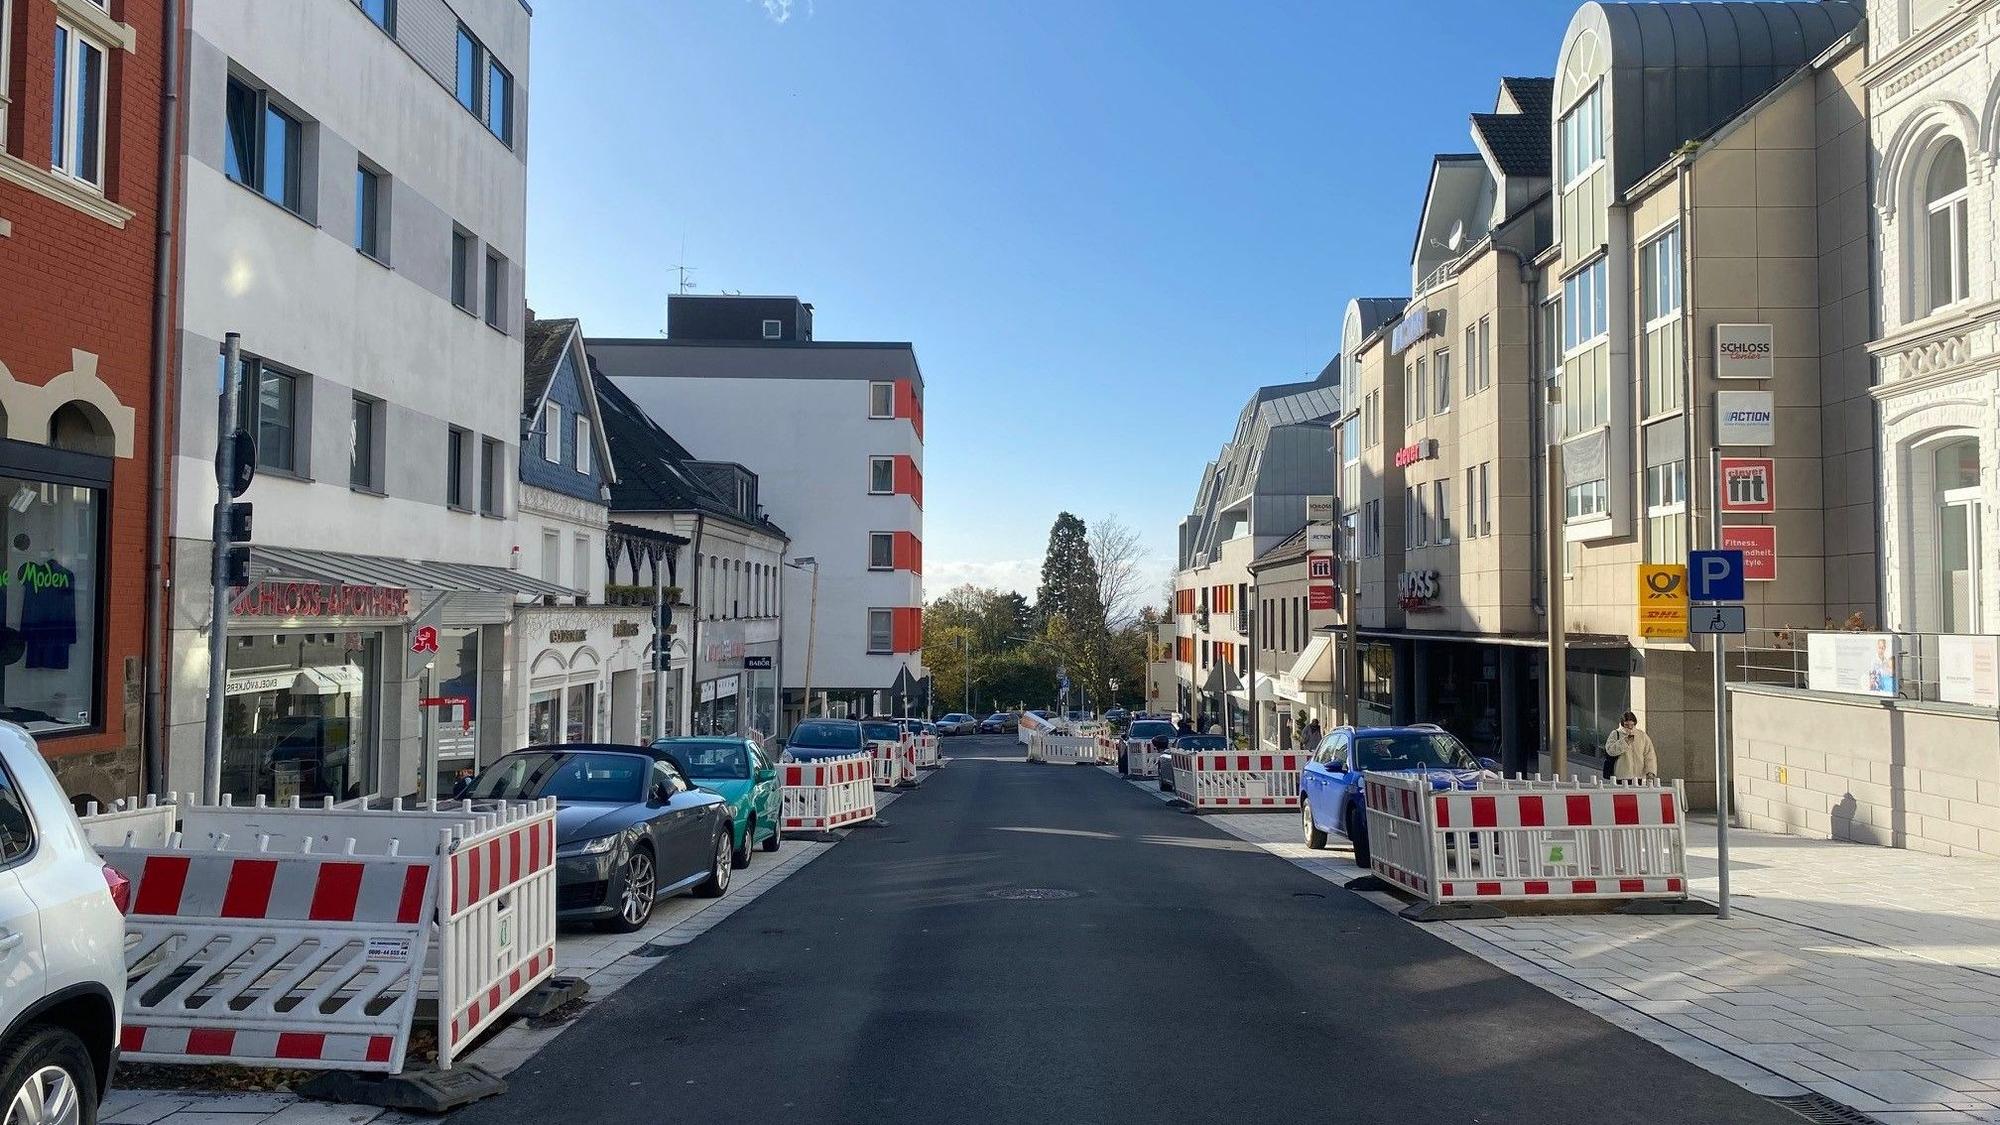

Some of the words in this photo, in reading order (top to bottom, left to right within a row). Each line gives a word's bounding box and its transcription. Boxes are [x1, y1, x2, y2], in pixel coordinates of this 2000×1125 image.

[1720, 342, 1770, 353] SCHLOSS
[1729, 411, 1770, 422] ACTION
[1727, 468, 1763, 478] clever
[1728, 475, 1765, 502] fit
[1724, 539, 1759, 547] Fitness.
[1745, 549, 1775, 557] ndheit.
[20, 560, 70, 594] Moden
[1701, 557, 1731, 595] P
